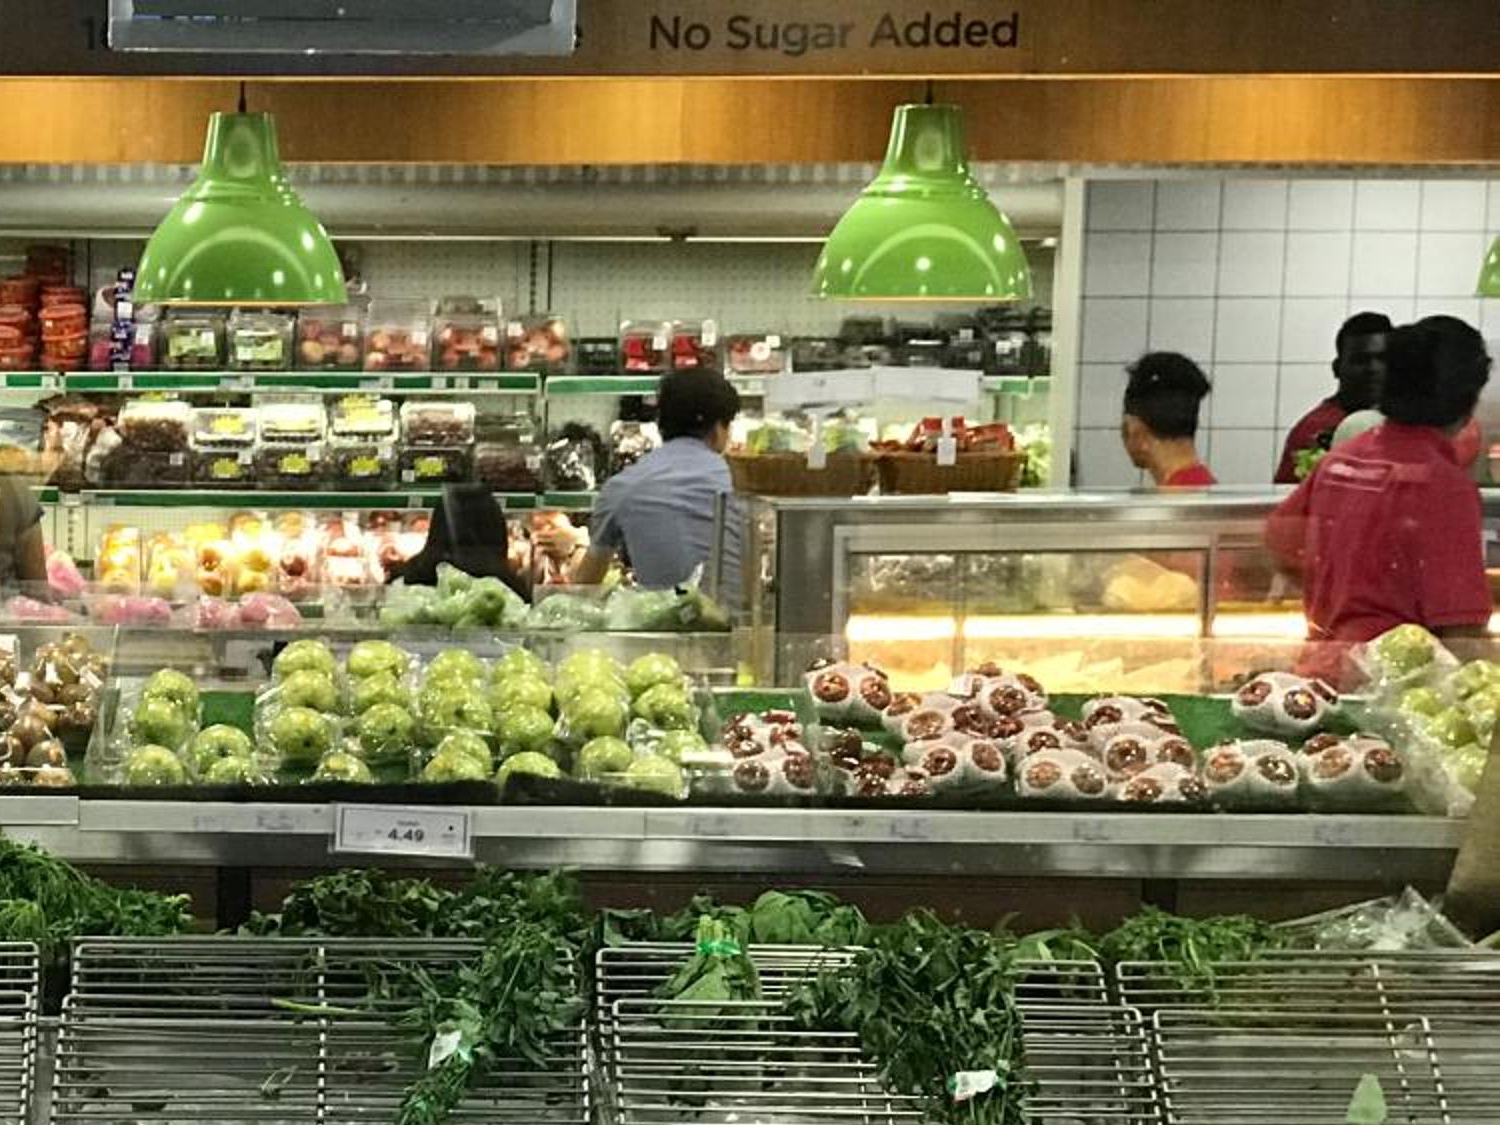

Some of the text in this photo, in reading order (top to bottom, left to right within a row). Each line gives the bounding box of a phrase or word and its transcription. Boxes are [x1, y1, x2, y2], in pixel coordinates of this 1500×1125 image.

[648, 12, 1020, 56] No Sugar Added
[388, 828, 424, 842] 4.49
